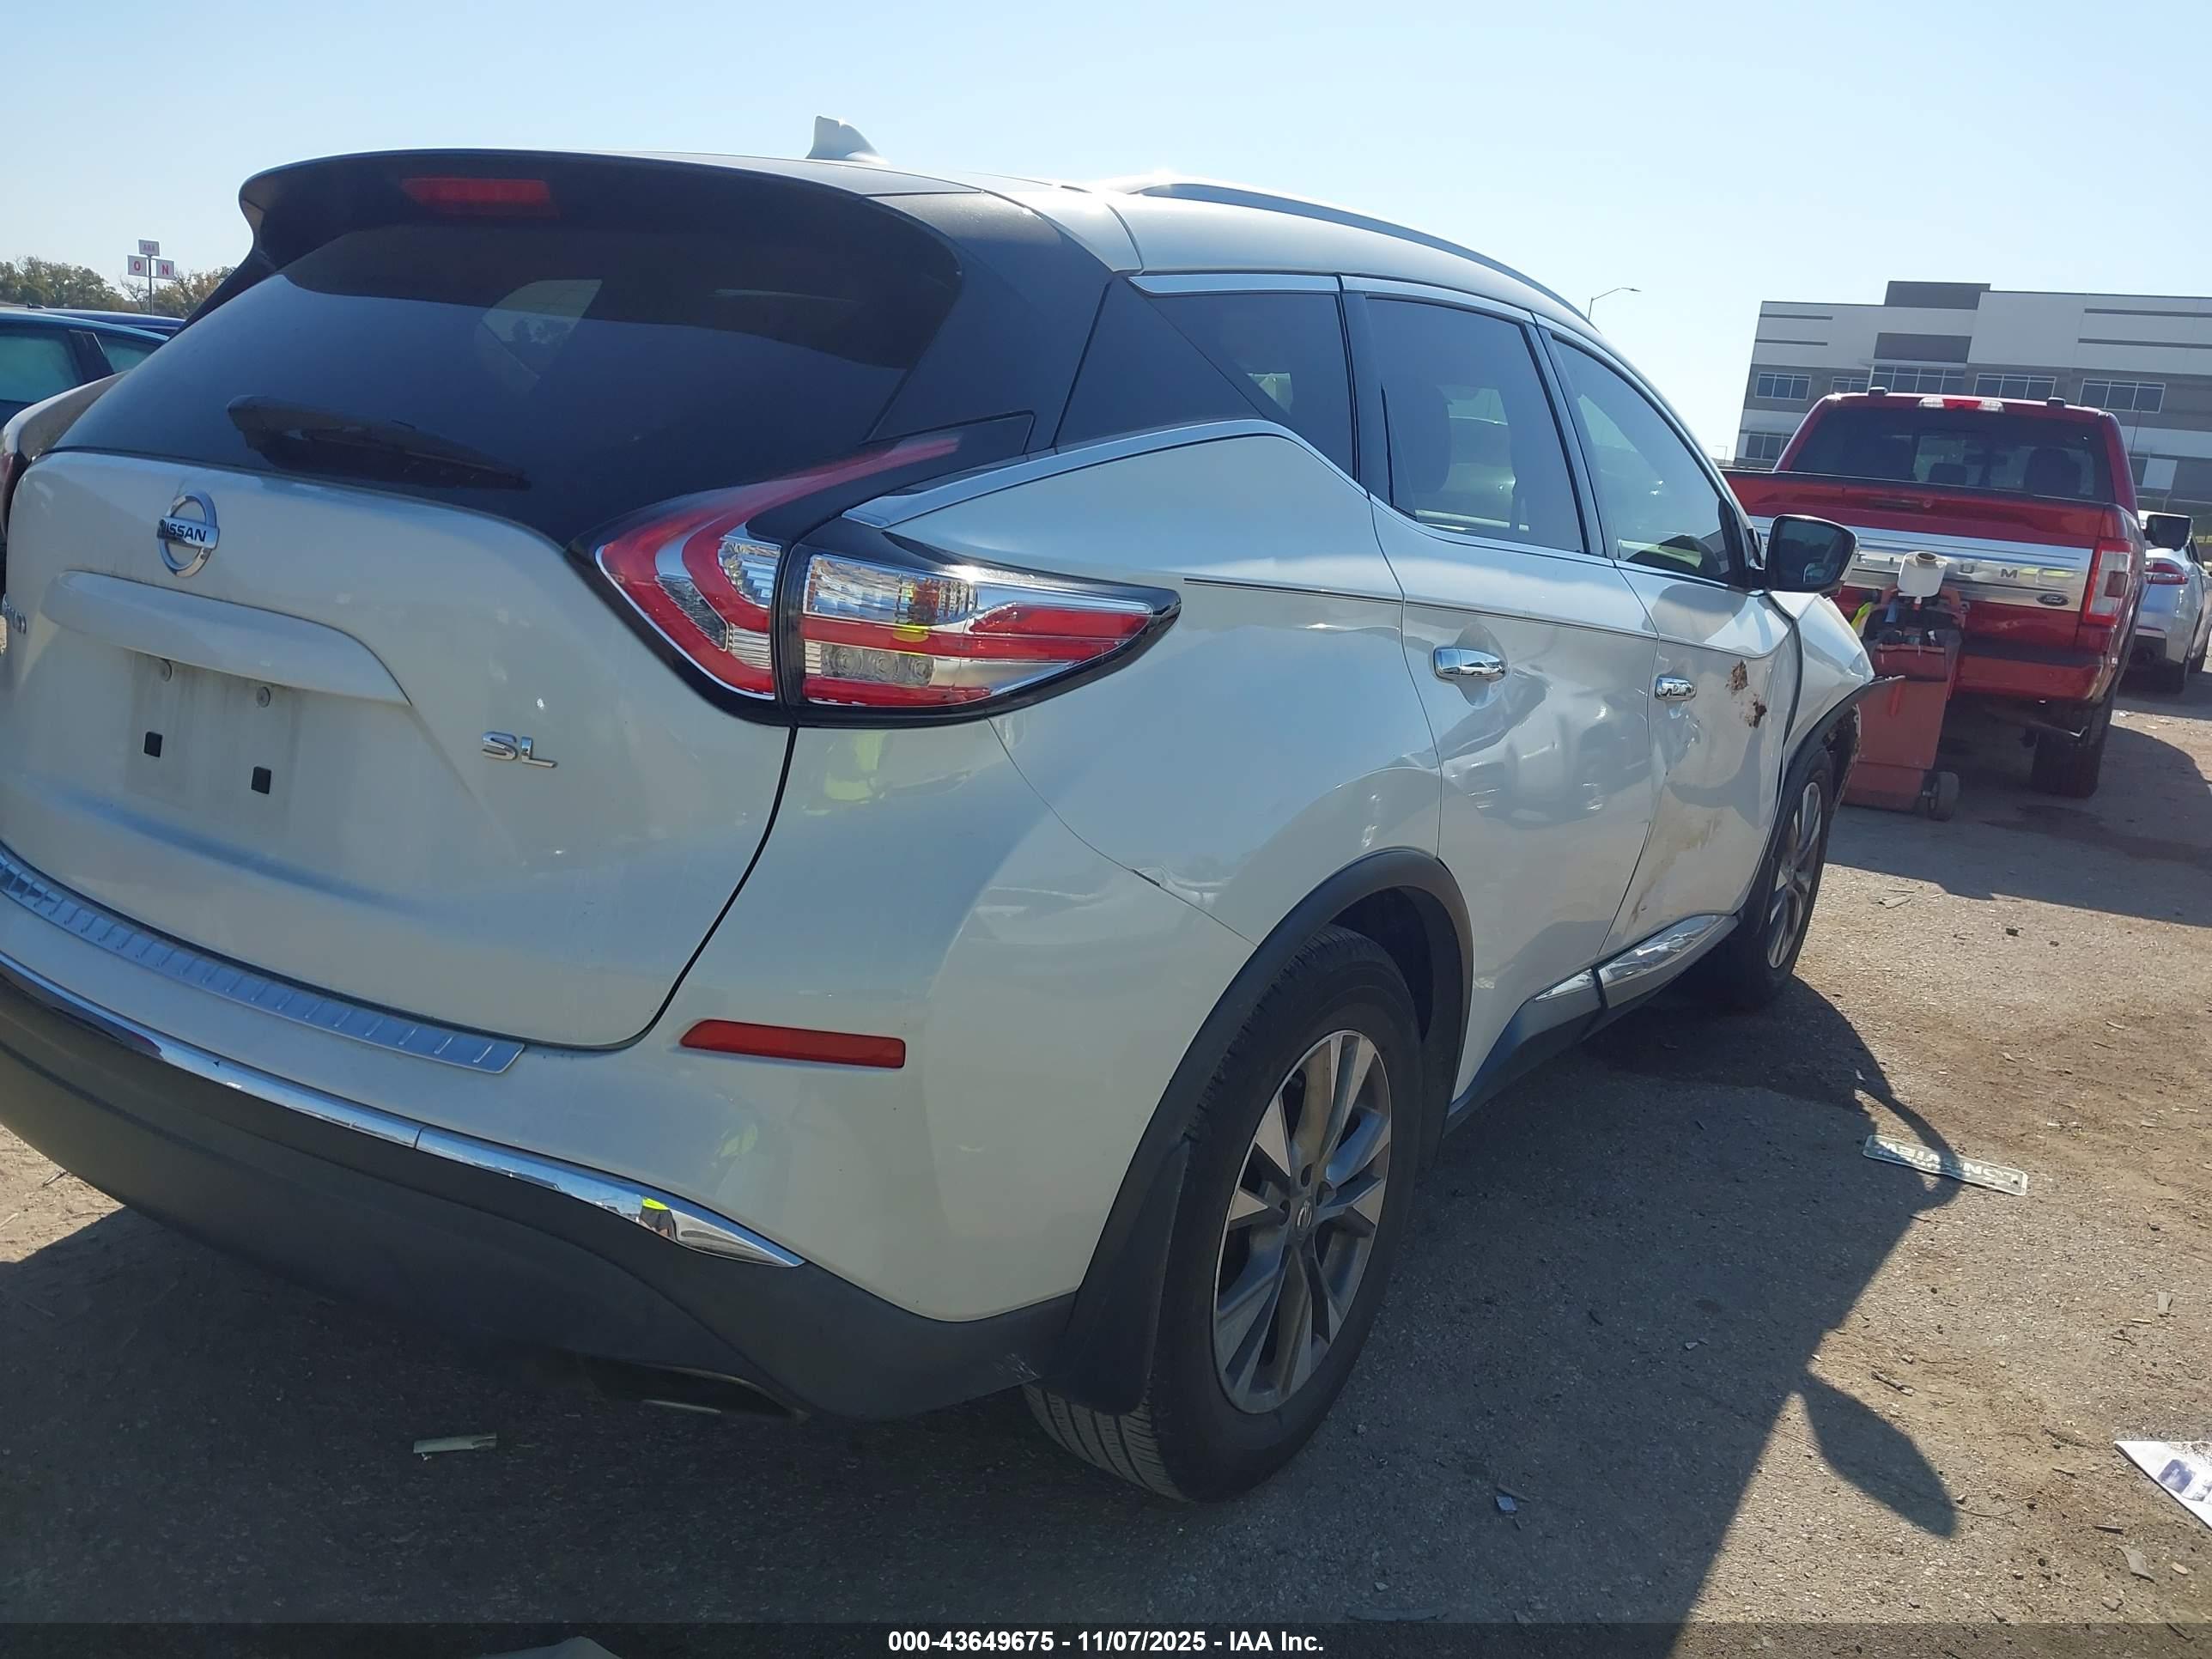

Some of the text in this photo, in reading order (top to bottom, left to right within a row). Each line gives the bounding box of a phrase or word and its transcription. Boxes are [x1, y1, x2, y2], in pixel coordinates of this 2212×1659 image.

[161, 264, 169, 275] N
[161, 520, 207, 544] NISSAN
[481, 730, 558, 769] SL
